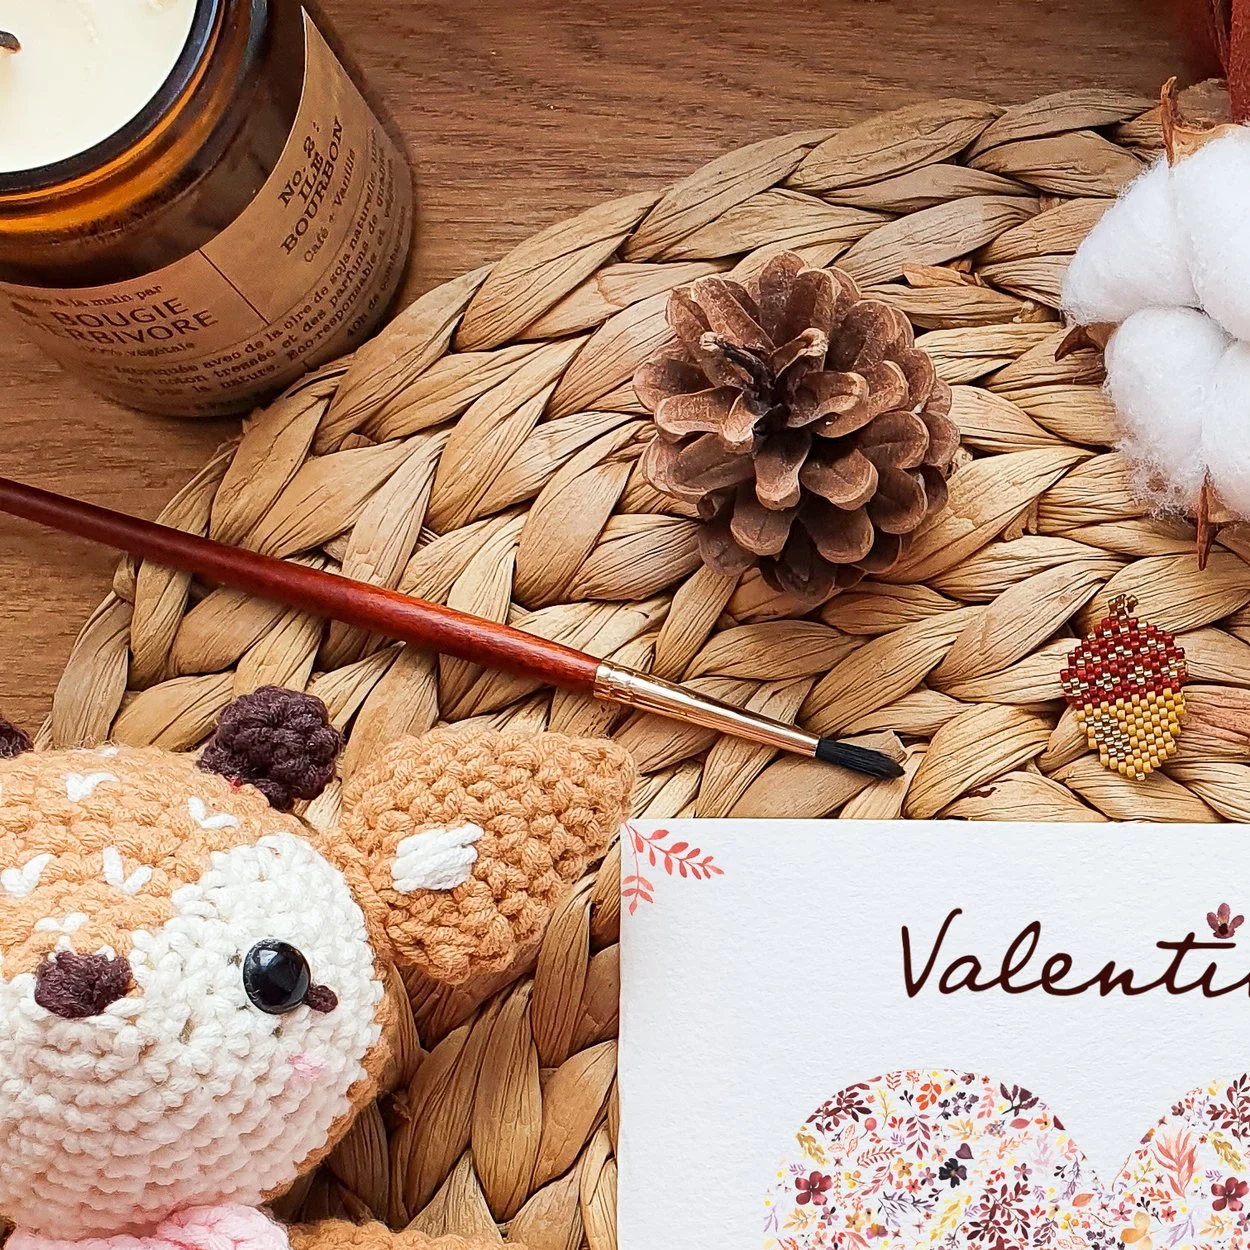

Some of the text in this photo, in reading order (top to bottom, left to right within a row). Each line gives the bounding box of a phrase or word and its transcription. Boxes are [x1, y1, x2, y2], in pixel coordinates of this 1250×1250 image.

[280, 115, 342, 255] BOURBON
[298, 151, 324, 204] ILE
[304, 227, 329, 263] Café
[334, 149, 355, 206] Vanille
[51, 297, 189, 328] BOUGIE
[92, 293, 132, 307] main
[136, 284, 163, 301] par
[203, 352, 241, 369] avec
[244, 340, 265, 353] de
[313, 286, 329, 304] de
[329, 253, 351, 285] soja
[282, 334, 298, 348] et
[303, 309, 327, 332] des
[329, 241, 369, 308] parfums
[368, 214, 378, 235] de
